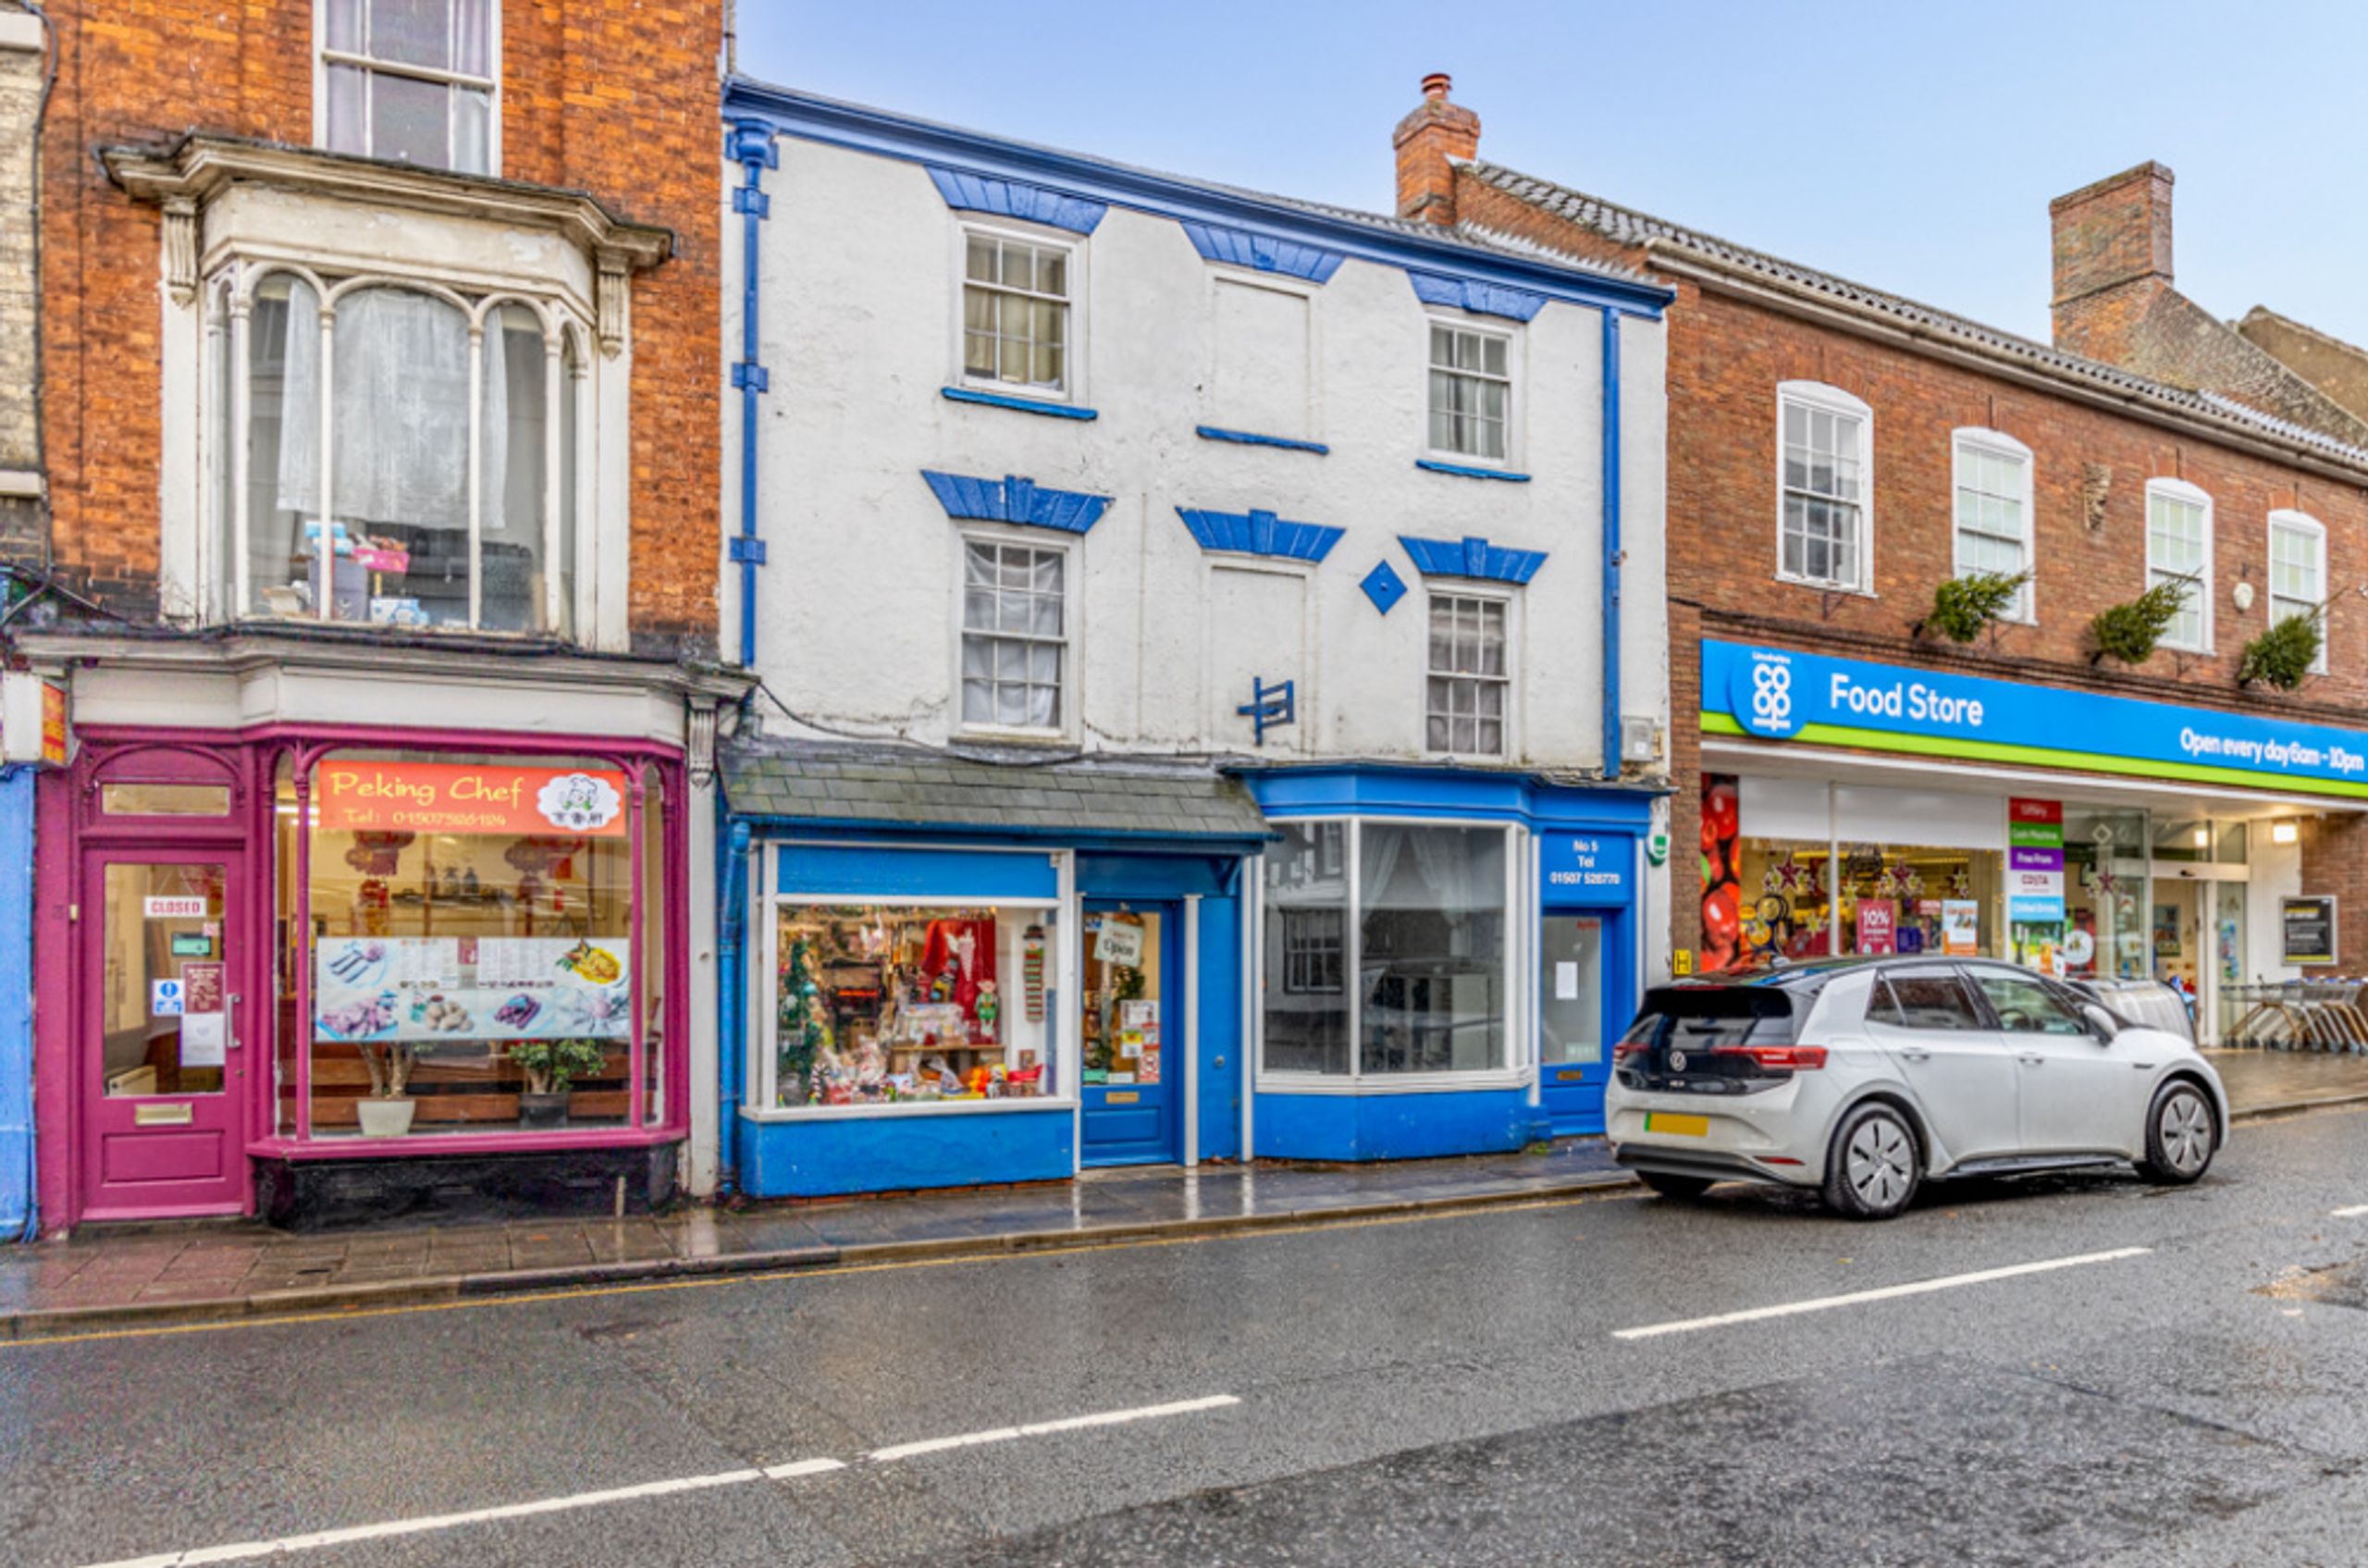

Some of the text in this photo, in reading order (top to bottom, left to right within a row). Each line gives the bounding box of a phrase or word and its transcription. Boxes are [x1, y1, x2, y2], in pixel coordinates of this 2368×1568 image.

[1831, 673, 1983, 727] Food Store
[2180, 727, 2221, 757] Open
[2223, 738, 2263, 764] every
[2263, 738, 2288, 768] day
[2288, 742, 2320, 765] 6am
[2328, 746, 2365, 774] 10pm
[329, 771, 525, 810] Peking Chef
[1573, 839, 1589, 852] No
[1577, 855, 1595, 869] Tel
[151, 901, 201, 913] CLOSED
[1864, 908, 1891, 925] 10%
[1676, 951, 1690, 972] H
